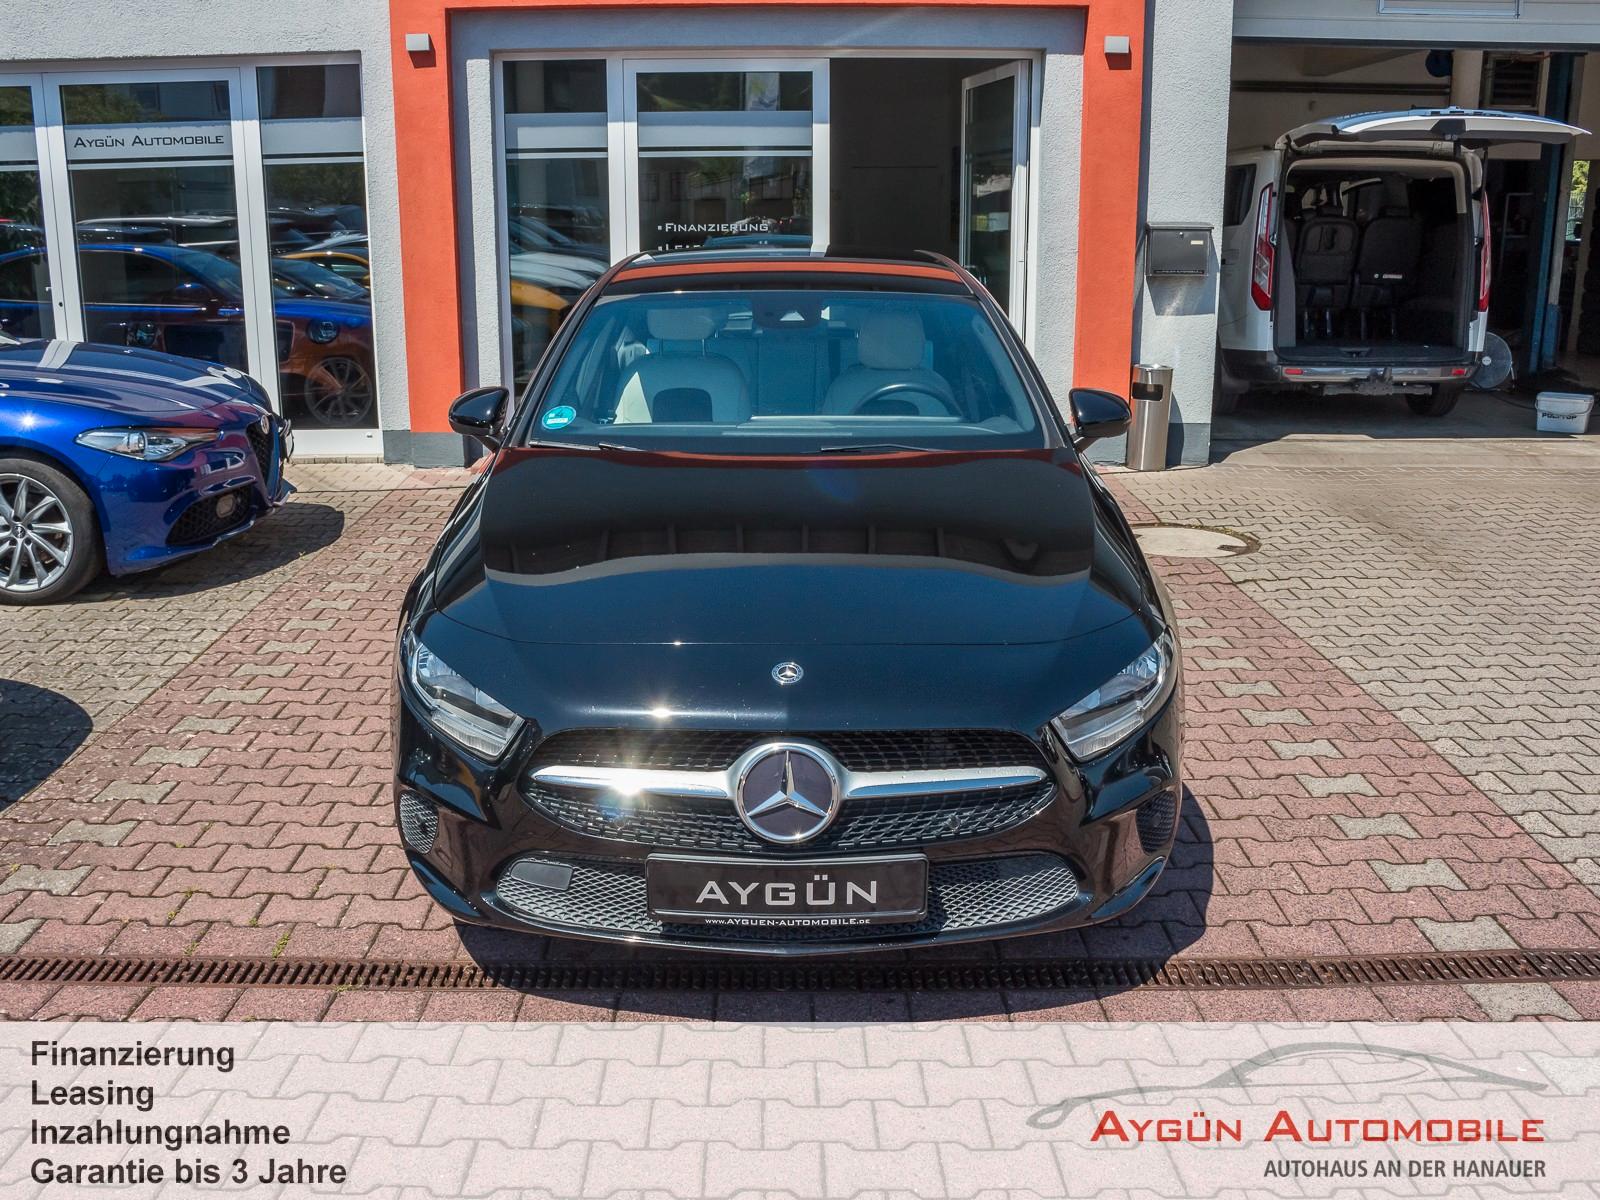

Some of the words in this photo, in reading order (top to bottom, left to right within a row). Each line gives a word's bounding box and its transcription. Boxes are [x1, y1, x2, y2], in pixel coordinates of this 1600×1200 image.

[131, 135, 225, 146] AUTOMOBILE
[665, 222, 769, 232] FINANZIERUNG
[695, 874, 877, 906] AYGÜN
